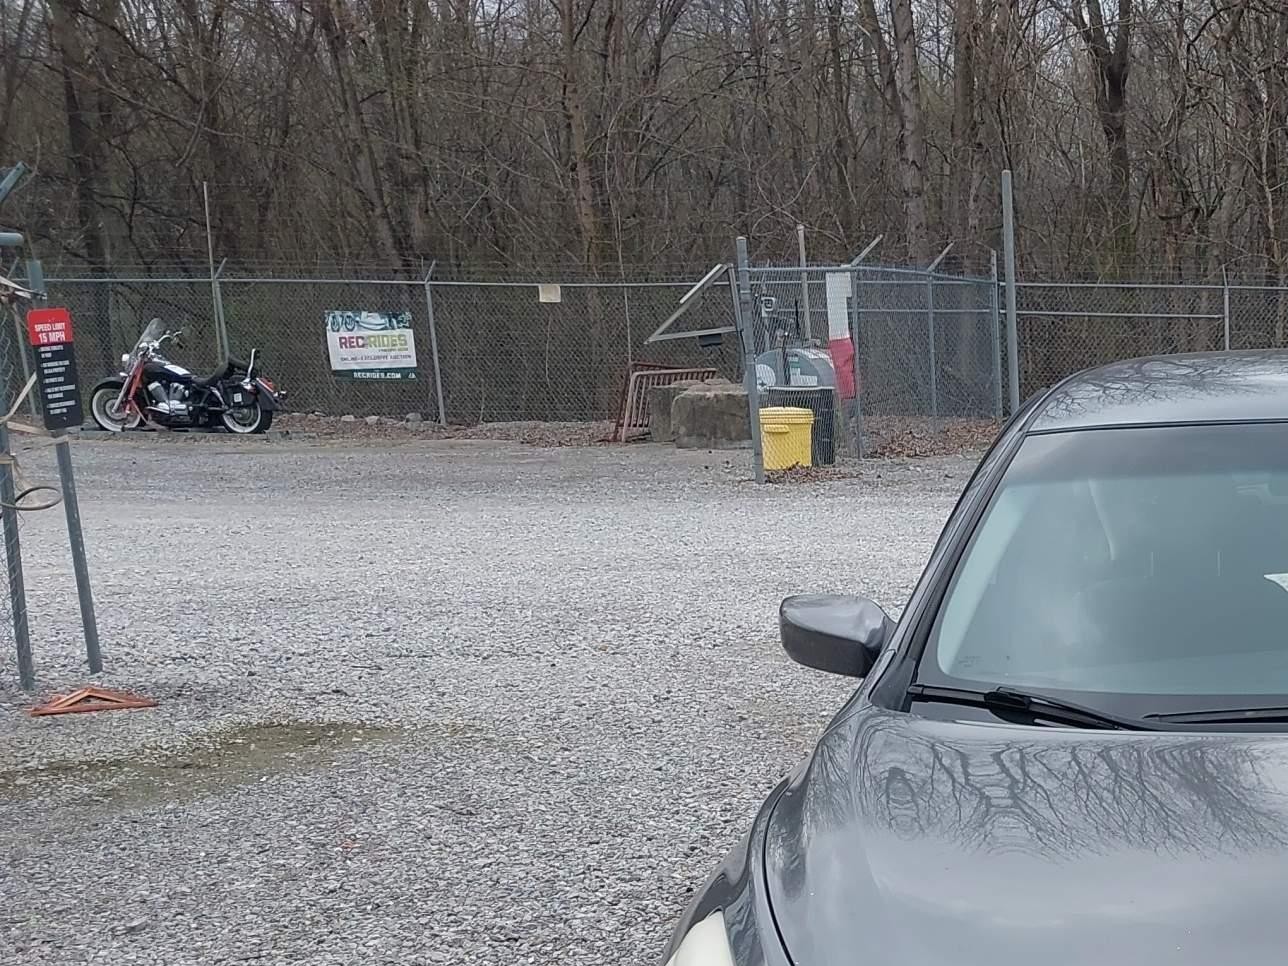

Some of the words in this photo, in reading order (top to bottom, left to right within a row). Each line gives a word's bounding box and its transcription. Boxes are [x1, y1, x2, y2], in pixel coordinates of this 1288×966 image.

[34, 323, 51, 332] SPEED
[52, 322, 66, 331] LIMIT
[39, 332, 48, 344] 15
[48, 331, 66, 343] MPH
[353, 371, 402, 379] RECRIDES.COM
